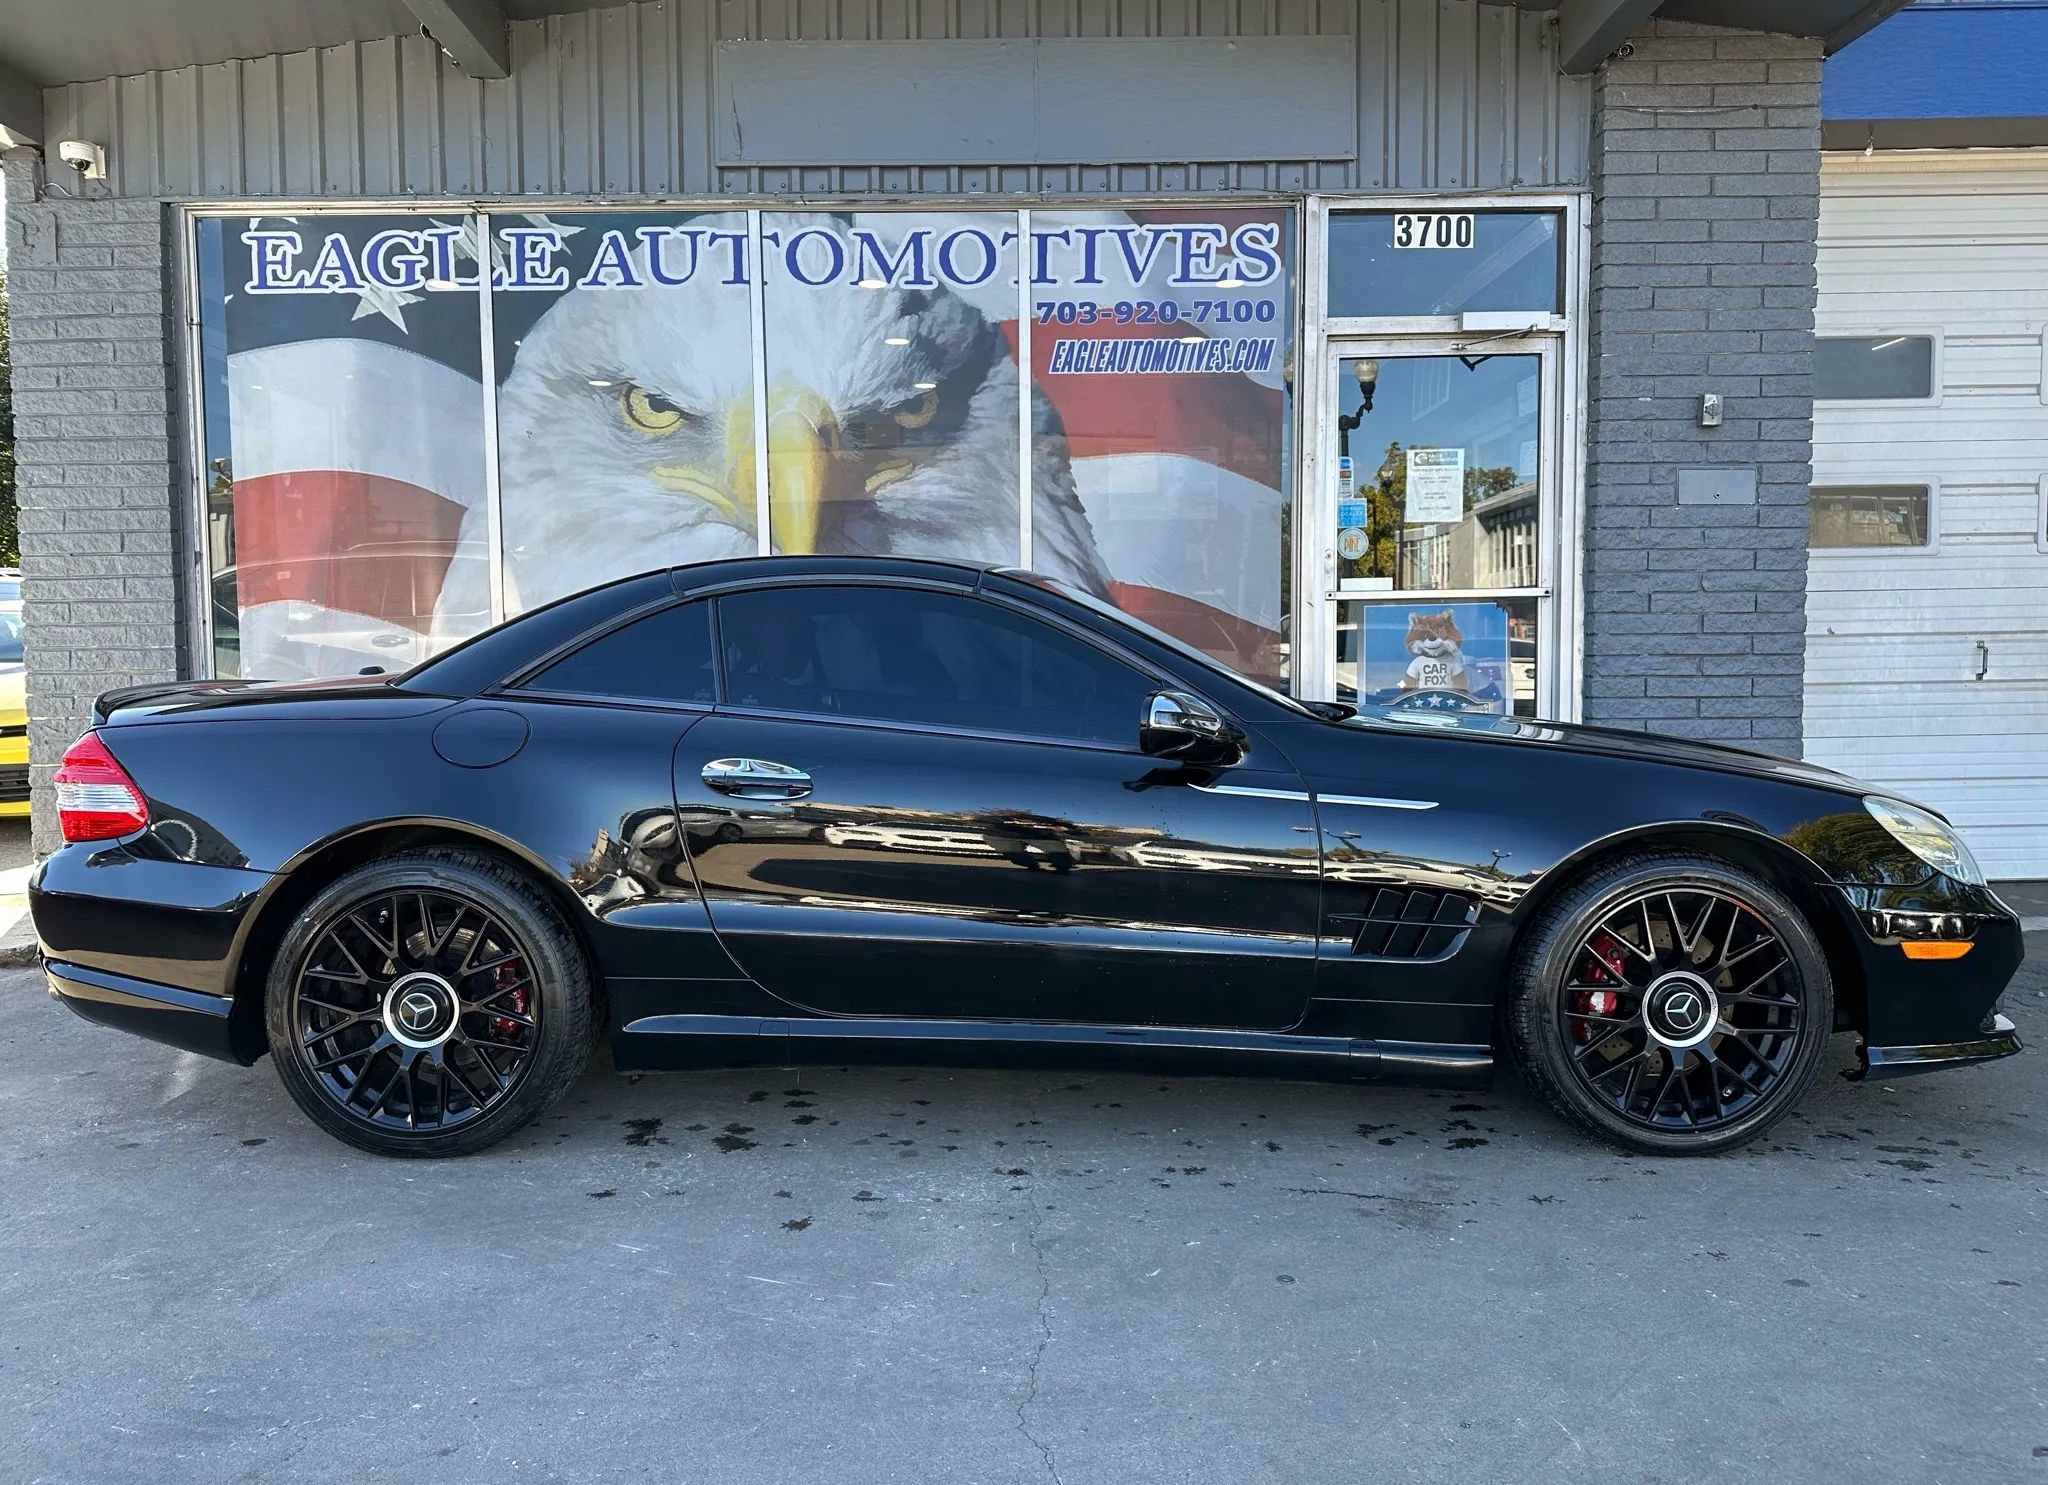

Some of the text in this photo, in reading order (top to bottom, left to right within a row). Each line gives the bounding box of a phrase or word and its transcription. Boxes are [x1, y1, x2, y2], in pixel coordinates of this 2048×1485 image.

[1396, 215, 1472, 248] 3700
[241, 223, 1281, 295] EAGLE AUTOMOTIVES
[1036, 300, 1276, 324] 703-920-7100
[1049, 337, 1277, 374] EAGLEAUTOMOTIVES.COM
[1423, 664, 1447, 675] CAR
[1424, 675, 1447, 686] FOX
